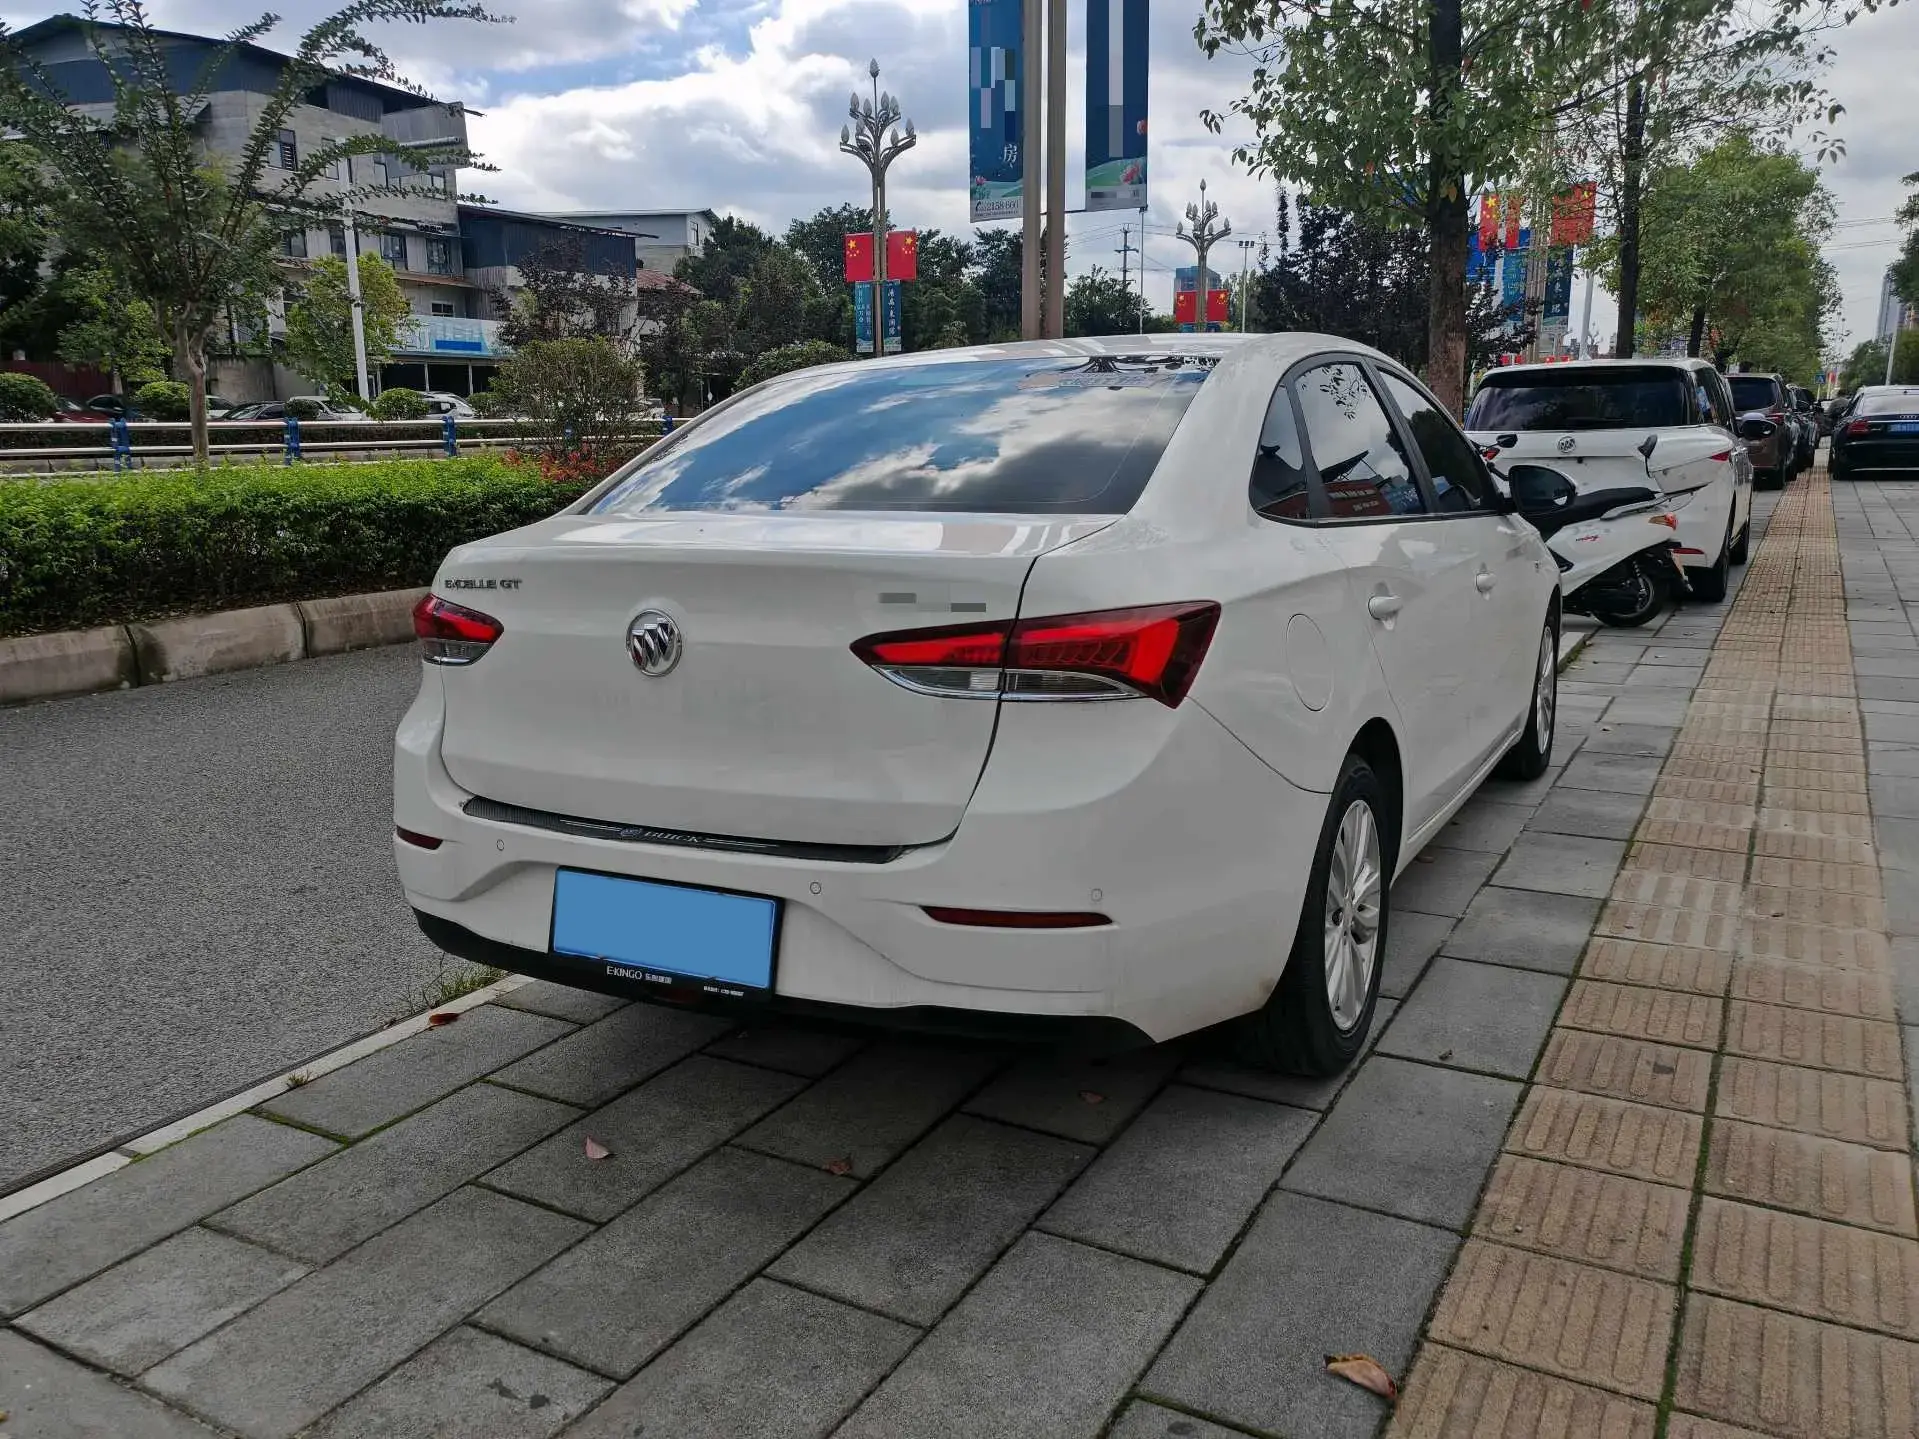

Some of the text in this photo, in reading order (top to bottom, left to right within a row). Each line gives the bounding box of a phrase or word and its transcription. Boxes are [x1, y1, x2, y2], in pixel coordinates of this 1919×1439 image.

[444, 579, 522, 589] EXCELLE GT
[645, 830, 699, 843] BUICK
